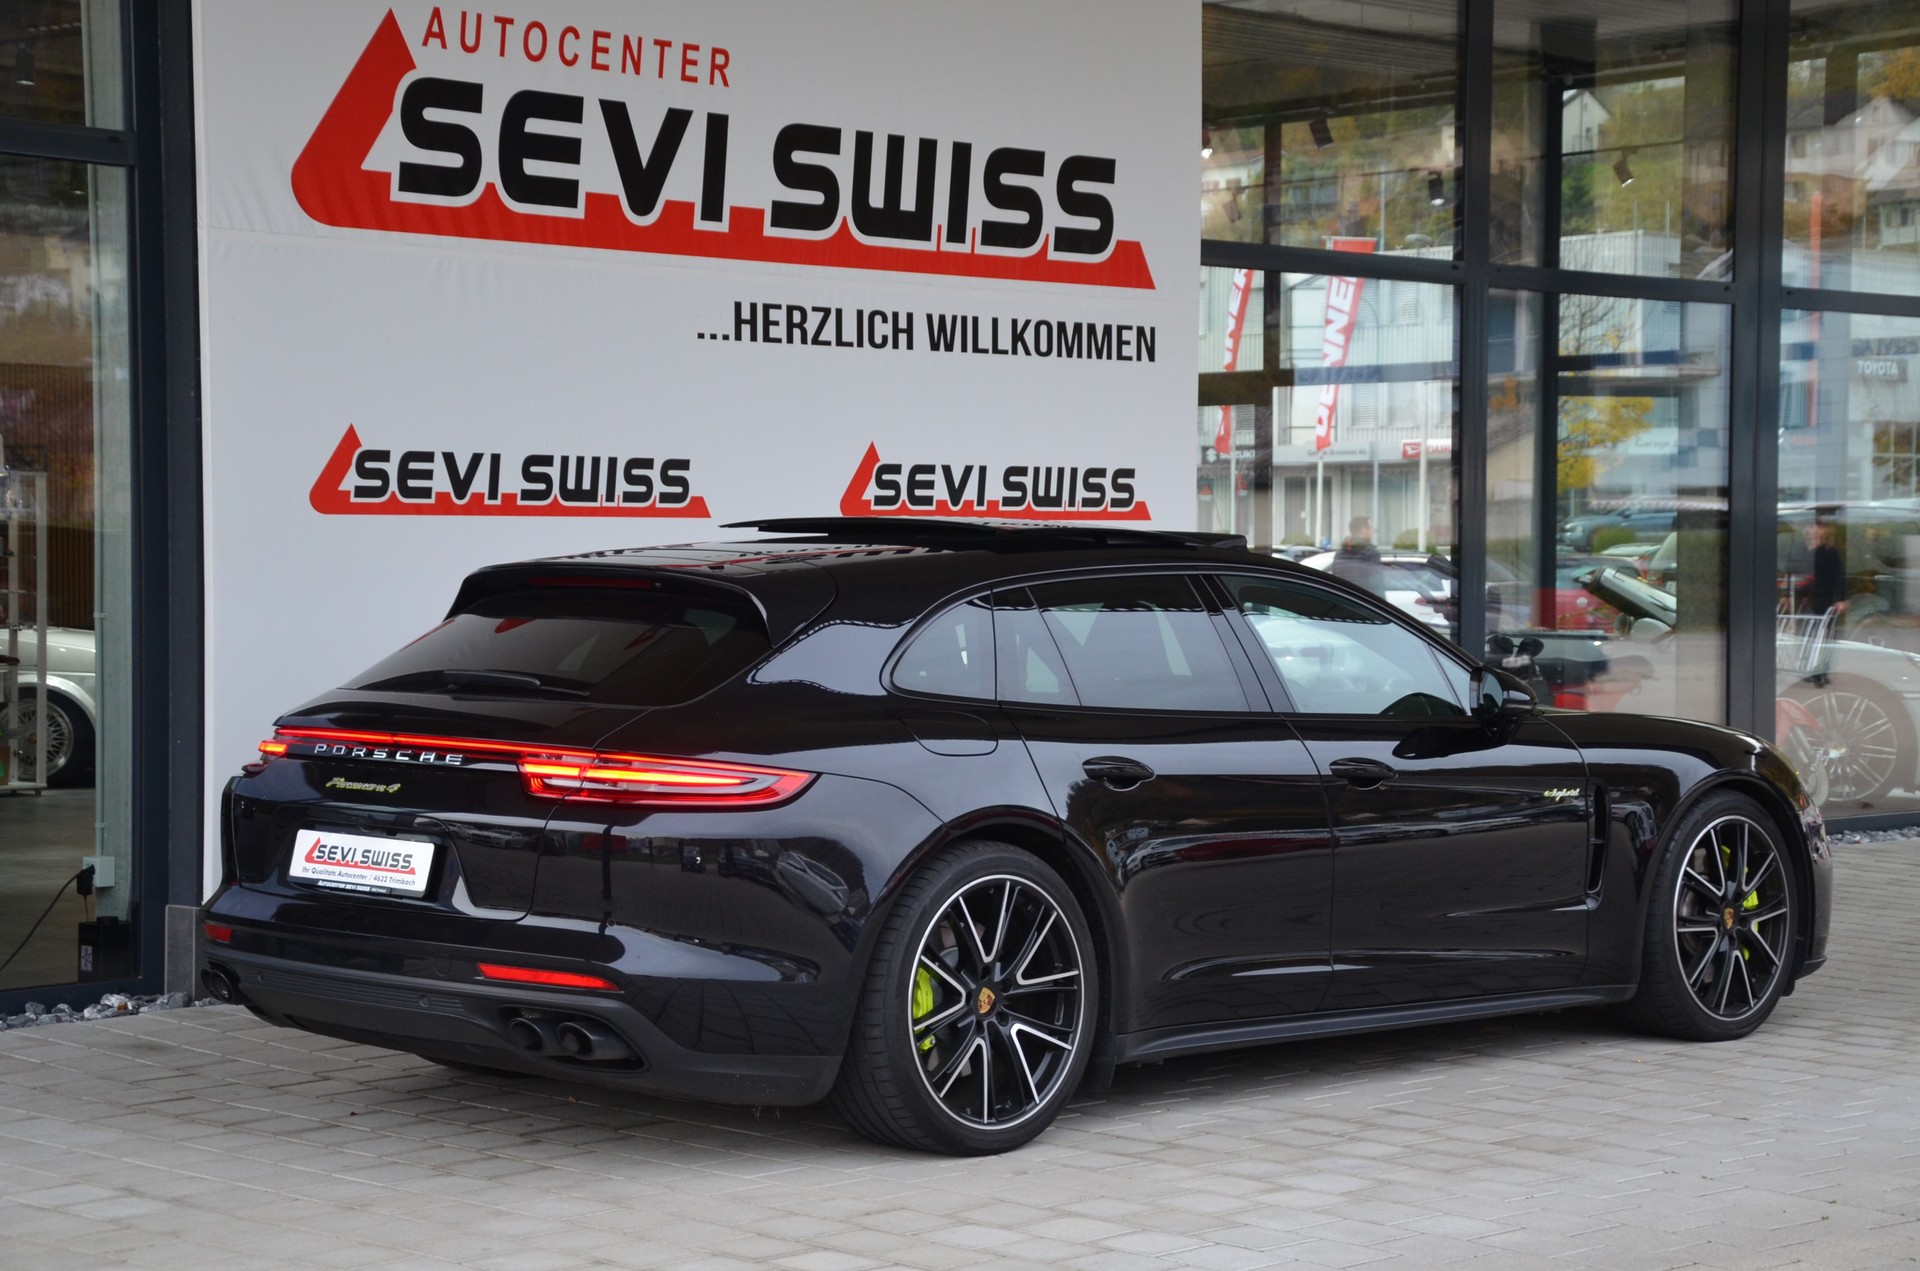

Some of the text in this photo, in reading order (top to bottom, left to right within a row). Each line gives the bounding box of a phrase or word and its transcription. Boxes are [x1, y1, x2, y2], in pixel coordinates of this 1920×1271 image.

[423, 7, 731, 88] AUTOCENTER
[398, 77, 1117, 255] SEVI SWISS
[926, 313, 1156, 363] WILLKOMMEN
[1857, 360, 1899, 377] TOYOTA
[353, 449, 691, 504] SEVI SWISS
[873, 463, 1136, 508] SEVI SWISS
[314, 743, 463, 766] PORSCHE
[315, 844, 413, 870] SEVI SWISS
[336, 870, 368, 881] Autocenter
[389, 876, 416, 886] Trimbach
